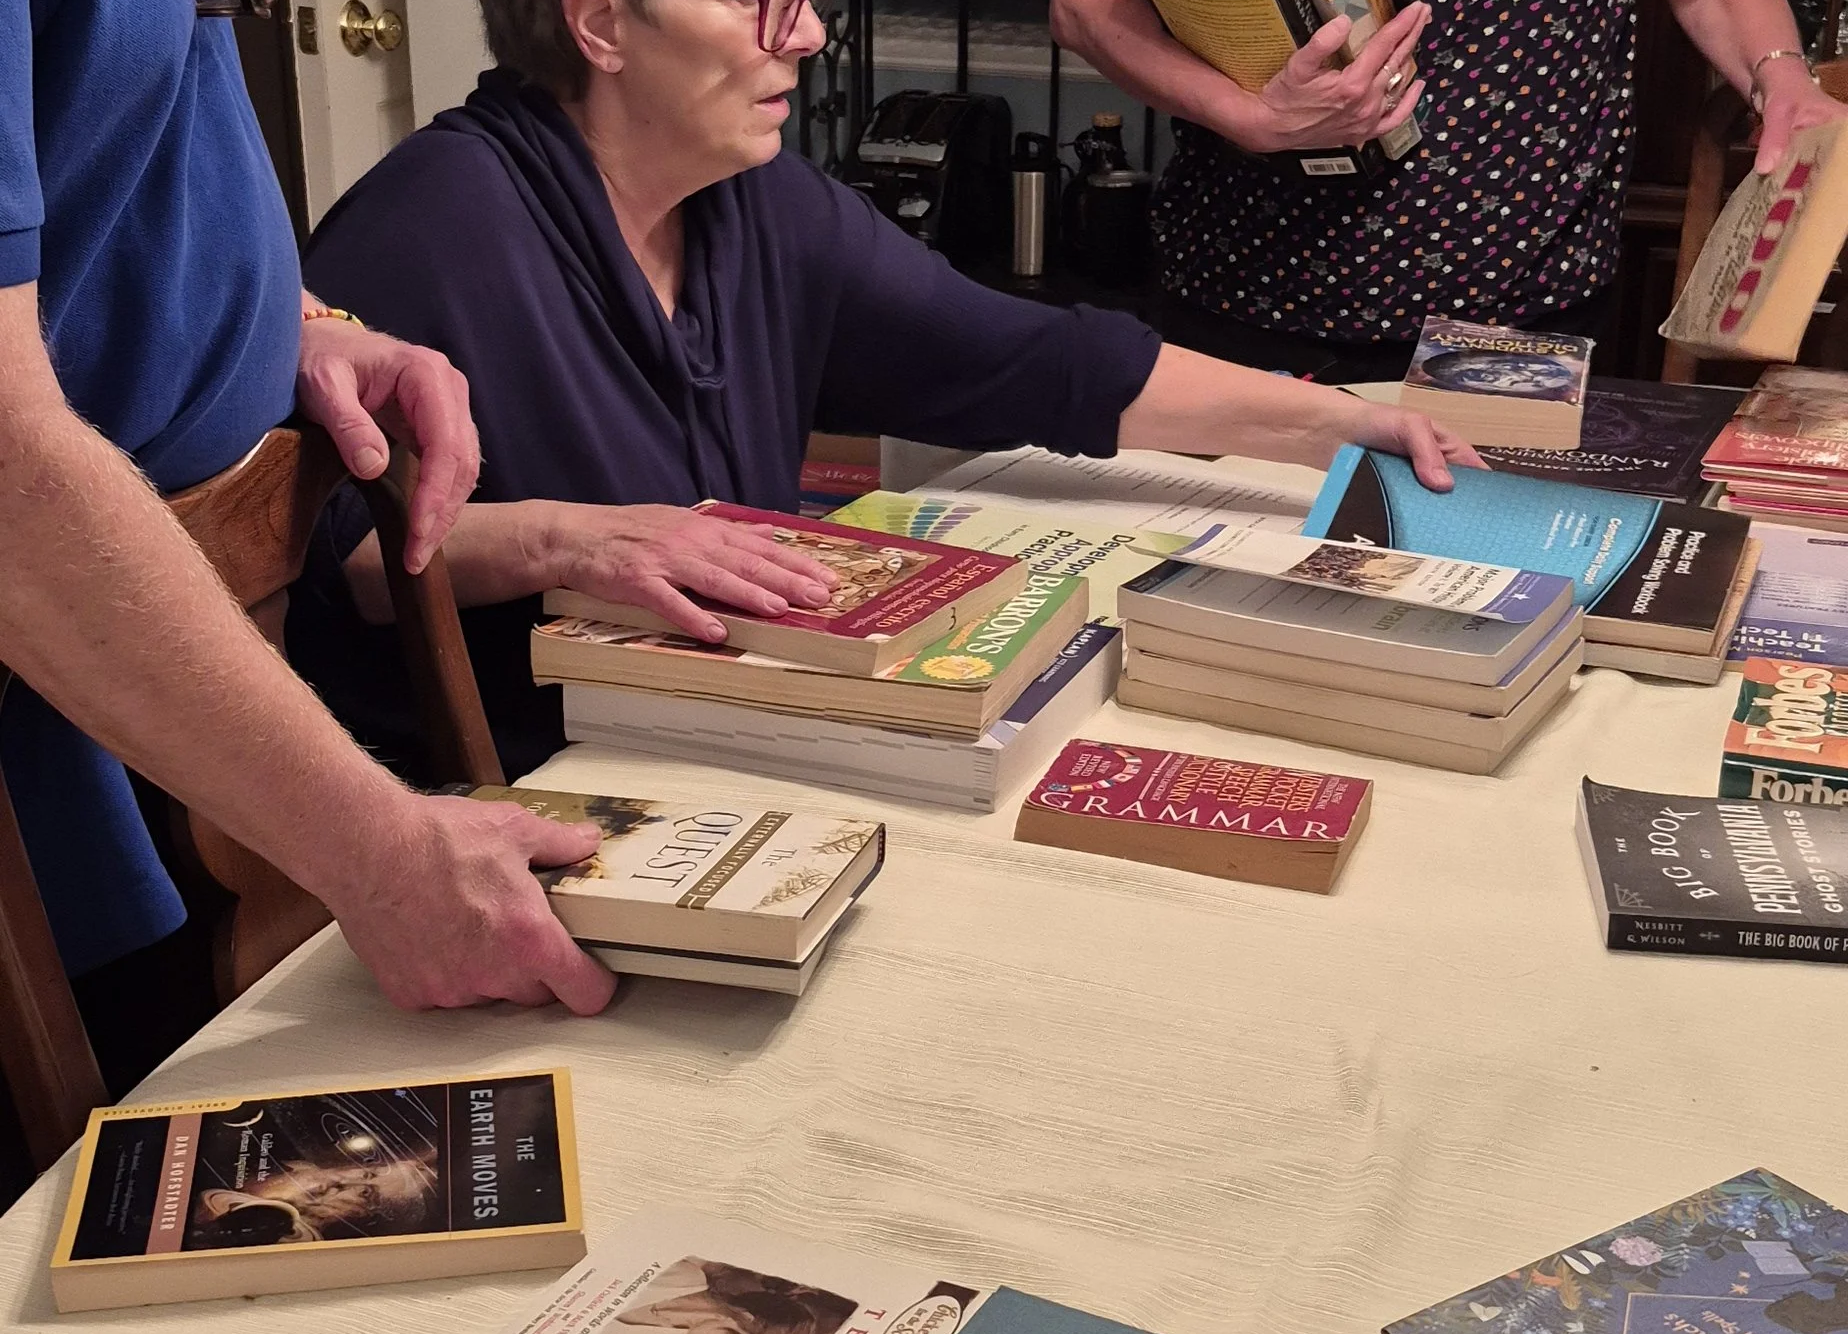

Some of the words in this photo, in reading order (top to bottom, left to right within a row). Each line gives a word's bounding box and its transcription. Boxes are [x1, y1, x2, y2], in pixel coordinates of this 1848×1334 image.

[1430, 333, 1579, 353] DICTIONARY
[1489, 446, 1614, 467] ASTONISHING
[1656, 527, 1683, 558] Problem
[1680, 530, 1706, 560] Practice
[928, 563, 999, 599] Español
[1482, 568, 1501, 585] Major
[1642, 558, 1671, 581] Solving
[1674, 560, 1692, 574] and
[1631, 581, 1661, 615] Workbook
[876, 598, 932, 628] escrito
[966, 573, 1066, 654] BARRON'S
[1065, 628, 1098, 655] KAPLAN
[1744, 666, 1833, 754] Forbes
[1068, 753, 1092, 776] EDITION
[1080, 755, 1103, 777] REVISED
[1100, 760, 1112, 774] NEW
[1167, 755, 1212, 805] DICTIONARY
[1196, 769, 1227, 795] STYLE
[1217, 768, 1255, 803] SPEECH
[1238, 767, 1281, 809] GRAMMAR
[1264, 776, 1297, 811] POCKET
[1040, 792, 1331, 840] GRAMMAR
[730, 817, 781, 862] EXTERNALLY
[1614, 837, 1629, 853] THE
[1648, 806, 1702, 857] BOOK
[1783, 809, 1821, 864] STORIES
[630, 811, 743, 889] QUEST
[761, 848, 798, 867] The
[1699, 848, 1713, 859] OF
[1716, 804, 1801, 915] PENNSYLVANIA
[698, 860, 737, 894] FOCUSED
[1662, 866, 1720, 899] BIG
[1807, 867, 1844, 913] GHOST
[1634, 920, 1684, 932] NESBITT
[1641, 934, 1686, 946] WILSON
[1738, 931, 1761, 946] THE
[1764, 933, 1785, 948] BIG
[1788, 934, 1821, 951] BOOK
[1824, 937, 1840, 951] OF
[470, 1089, 495, 1146] EARTH
[174, 1135, 189, 1156] DAN
[240, 1130, 253, 1153] Roman
[260, 1132, 274, 1155] Galileo
[515, 1135, 535, 1161] THE
[233, 1153, 251, 1189] Inquisition
[257, 1167, 271, 1182] the
[258, 1156, 270, 1167] and
[160, 1161, 185, 1231] HOFSTADTER
[472, 1154, 499, 1219] MOVES
[651, 1261, 662, 1269] A
[620, 1268, 655, 1299] Collection
[612, 1296, 625, 1307] in
[589, 1305, 616, 1328] Words
